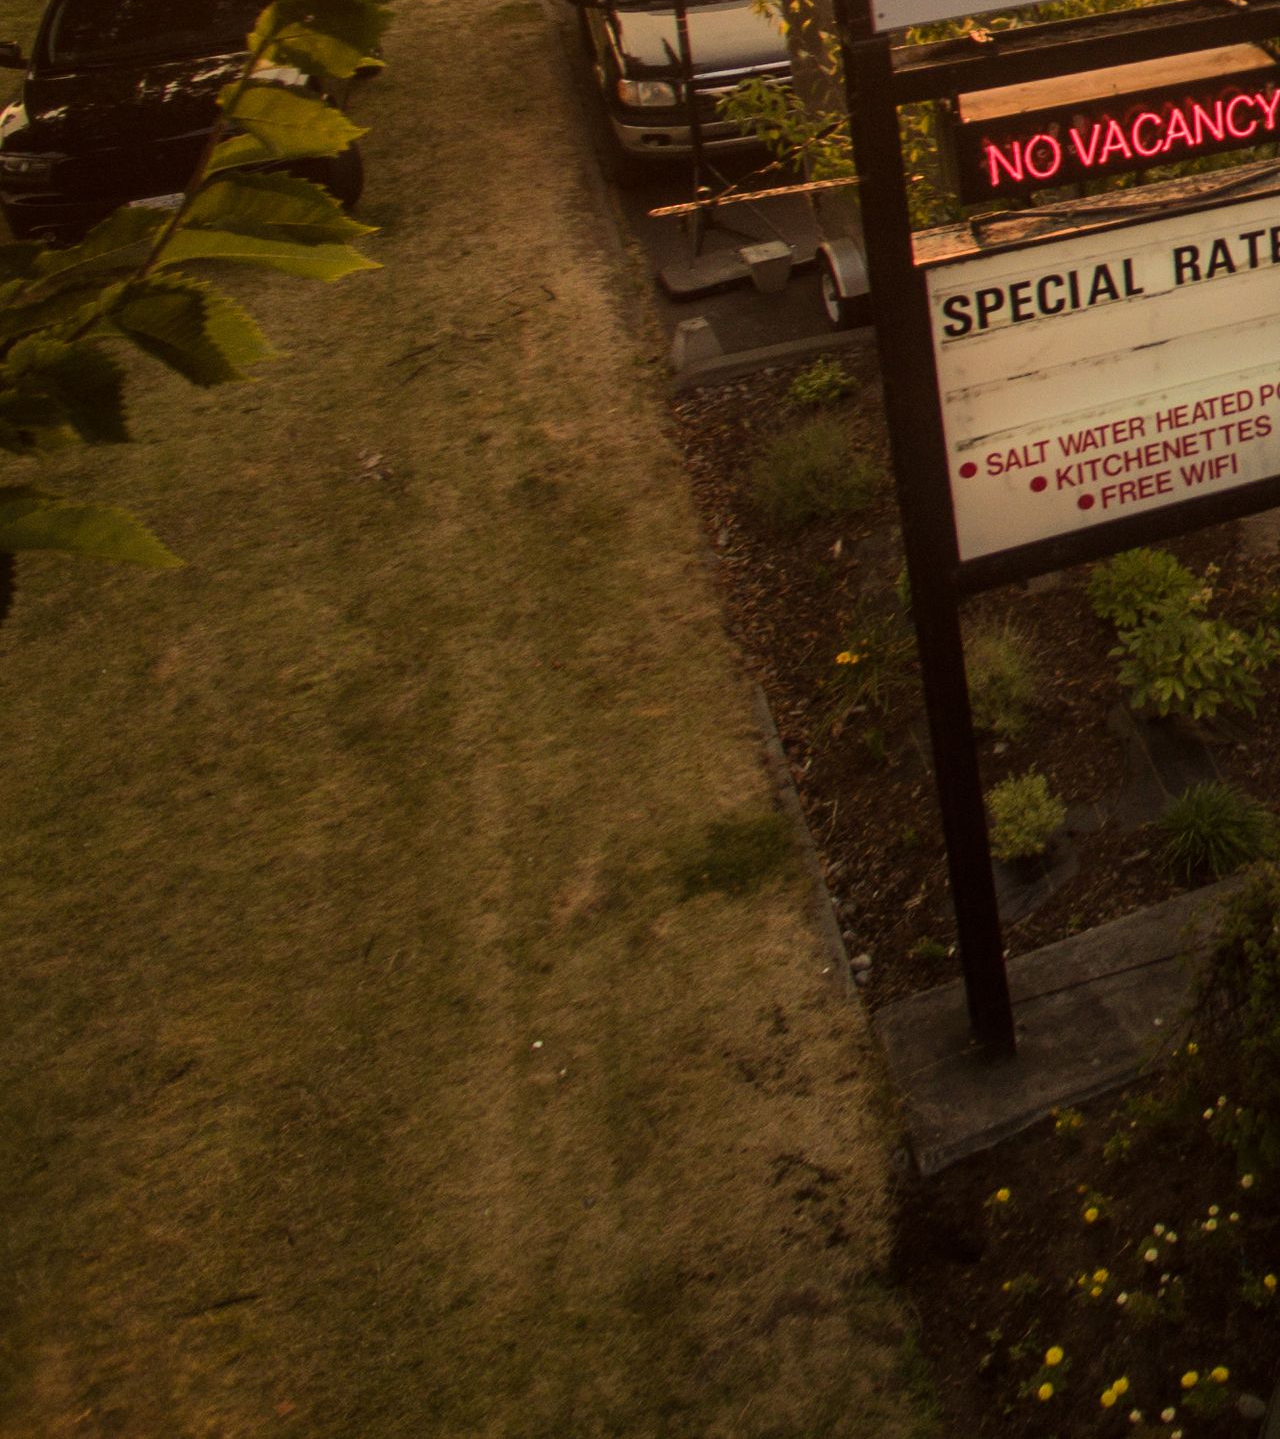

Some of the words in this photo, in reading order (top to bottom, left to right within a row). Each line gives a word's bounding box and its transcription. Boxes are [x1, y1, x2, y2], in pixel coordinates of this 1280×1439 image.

[986, 133, 1062, 187] NO
[942, 257, 1144, 338] SPECIAL
[986, 440, 1049, 477] SALT
[1057, 418, 1146, 462] WATER
[1155, 394, 1255, 443] HEATED
[1056, 416, 1273, 491] KITCHENETTES
[1101, 473, 1174, 510] FREE
[1186, 453, 1240, 494] WIFI
